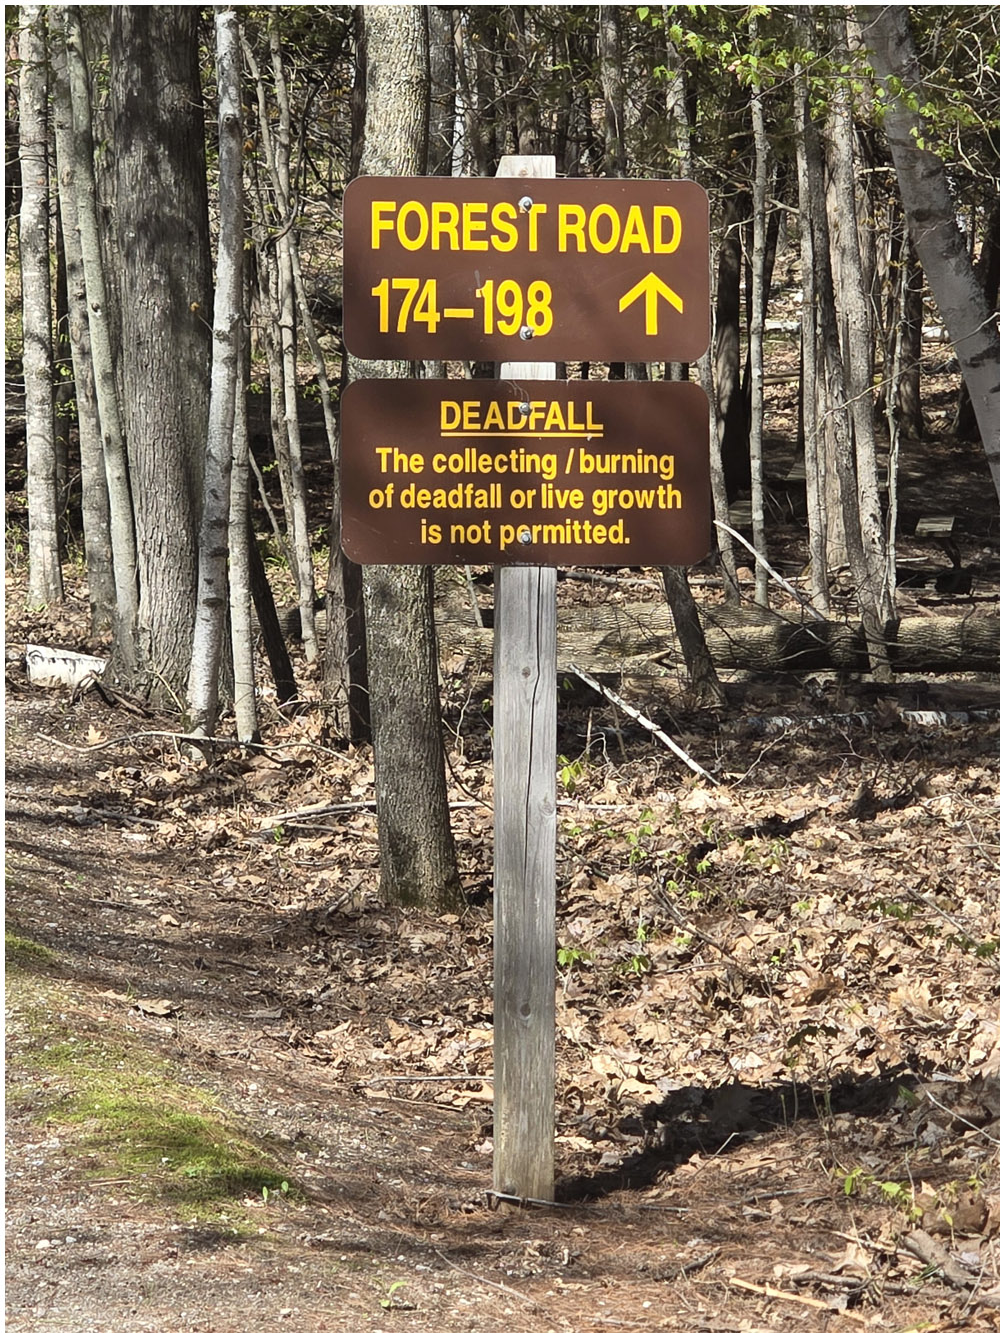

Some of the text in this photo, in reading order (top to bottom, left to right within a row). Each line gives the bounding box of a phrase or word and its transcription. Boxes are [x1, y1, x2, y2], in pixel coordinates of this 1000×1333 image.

[371, 200, 682, 254] FOREST ROAD
[440, 401, 604, 431] DEADFALL
[375, 447, 424, 474] The
[432, 448, 557, 479] collecting
[580, 448, 675, 479] burning
[368, 483, 683, 515] of deadfall or live growth
[420, 519, 442, 545] is
[450, 521, 492, 545] not
